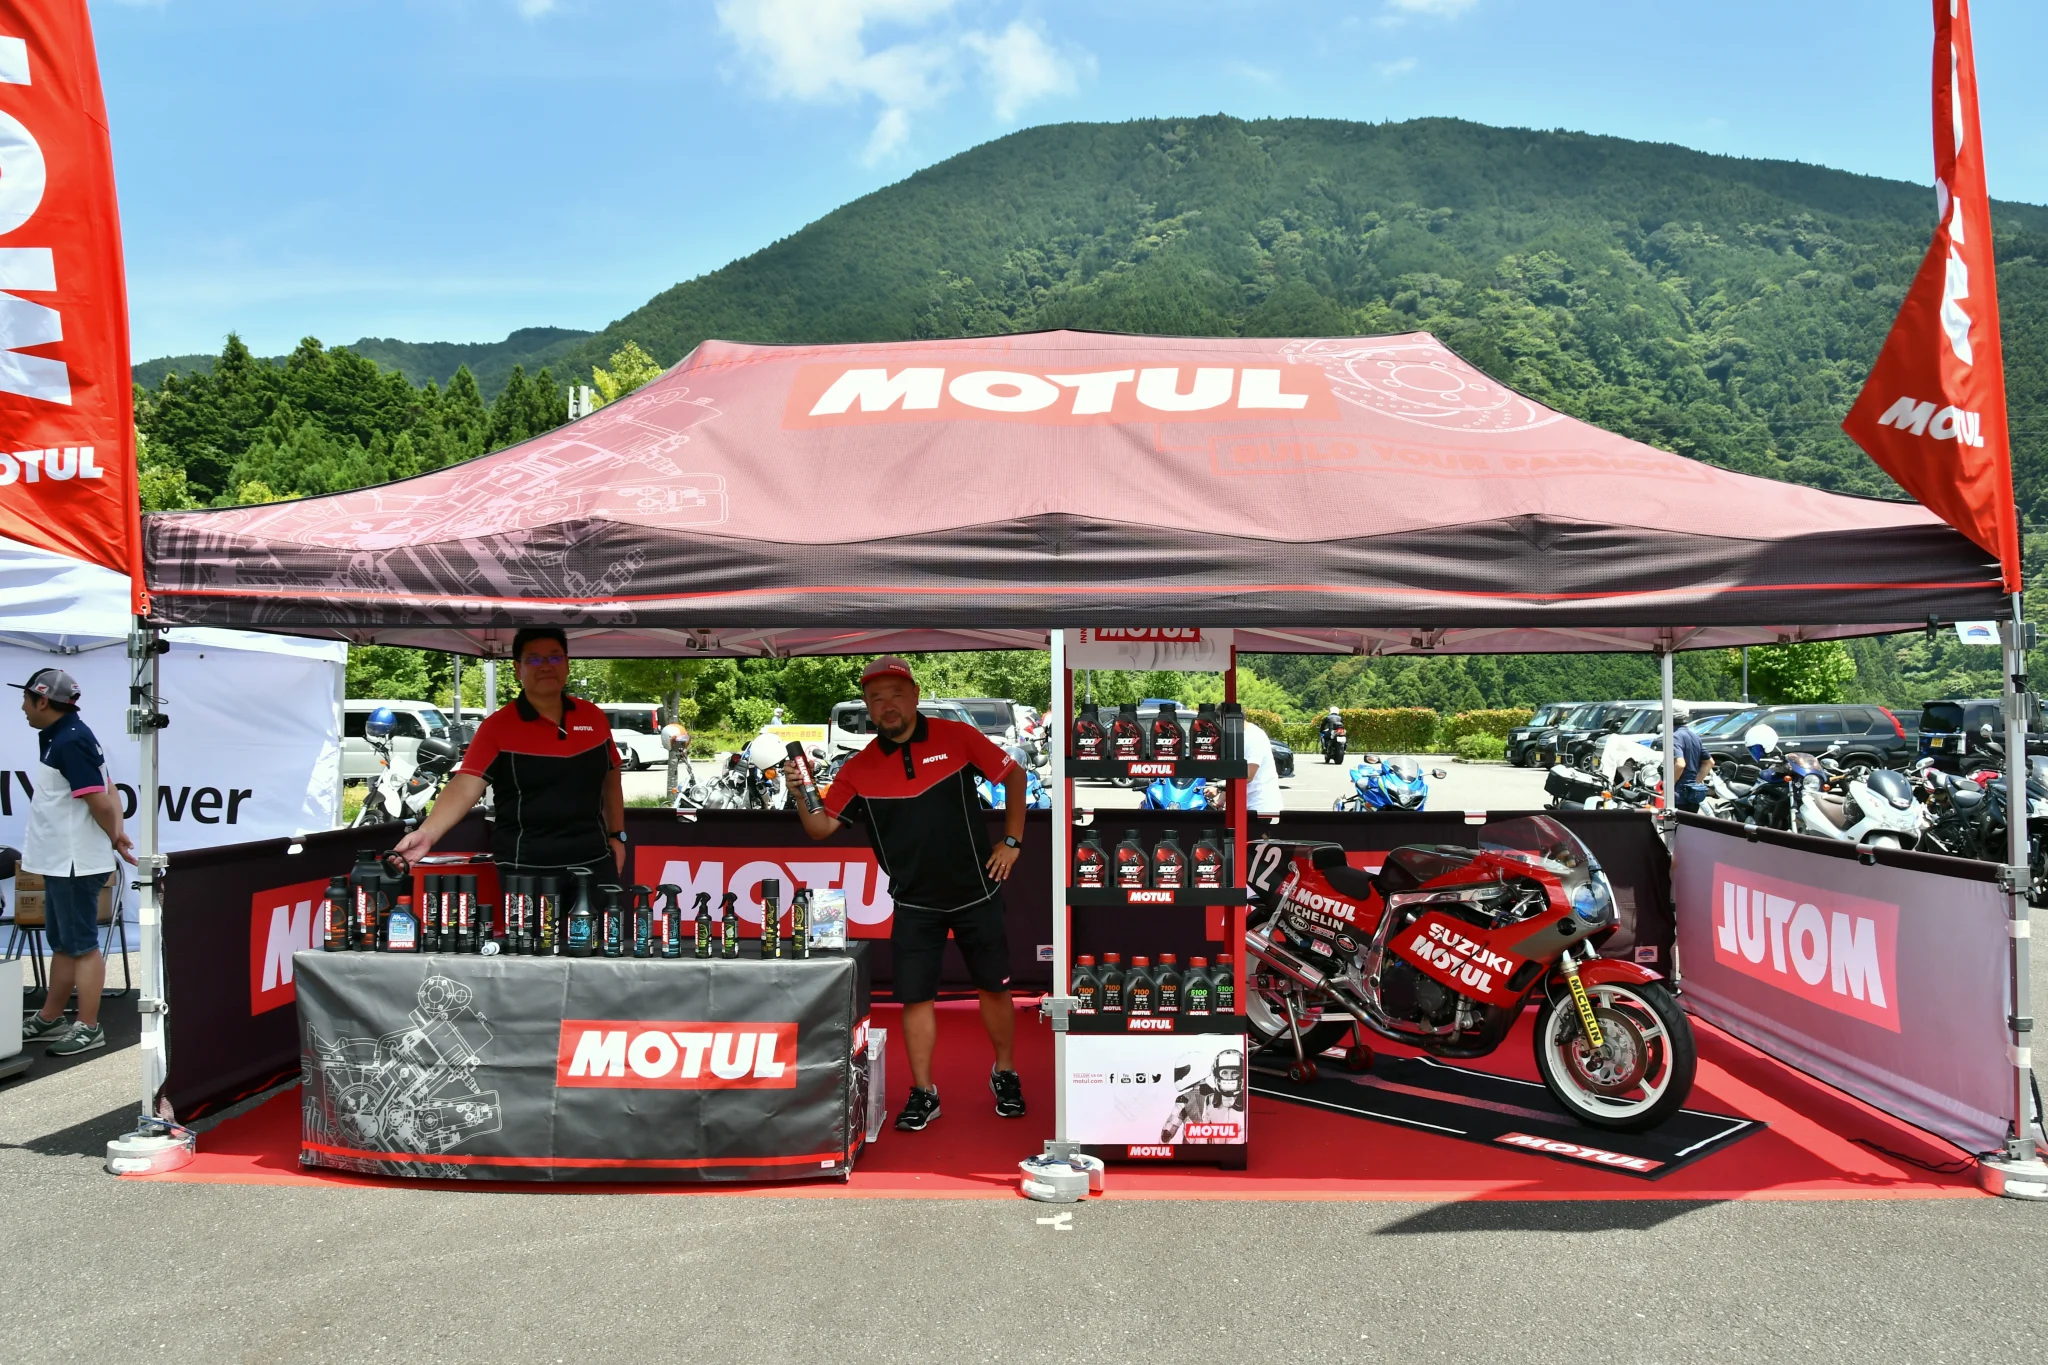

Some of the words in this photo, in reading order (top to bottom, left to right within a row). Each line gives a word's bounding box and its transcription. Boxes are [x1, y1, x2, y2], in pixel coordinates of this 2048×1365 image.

[809, 368, 1309, 415] MOTUL
[1232, 441, 1359, 463] BUILD
[1371, 443, 1489, 470] YOUR
[1502, 455, 1689, 474] PASSION
[1078, 737, 1102, 745] 300V
[1116, 737, 1140, 745] 300V
[1156, 737, 1180, 745] 300V
[1195, 736, 1219, 744] 300V
[922, 753, 948, 764] MOTUL
[1130, 764, 1172, 774] MOTUL
[1248, 843, 1282, 892] 12
[1130, 892, 1172, 902] MOTUL
[1295, 888, 1356, 922] MOTUL
[1282, 900, 1344, 931] MICHELIN
[1428, 922, 1514, 976] SUZUKI
[1409, 934, 1493, 994] MOTUL
[1570, 978, 1602, 1041] MICHELIN
[1130, 1020, 1171, 1029] MOTUL
[567, 1030, 786, 1079] MOTUL
[1188, 1125, 1235, 1137] MOTUL
[1130, 1147, 1171, 1156] MOTUL
[1504, 1135, 1649, 1169] MOTUL
